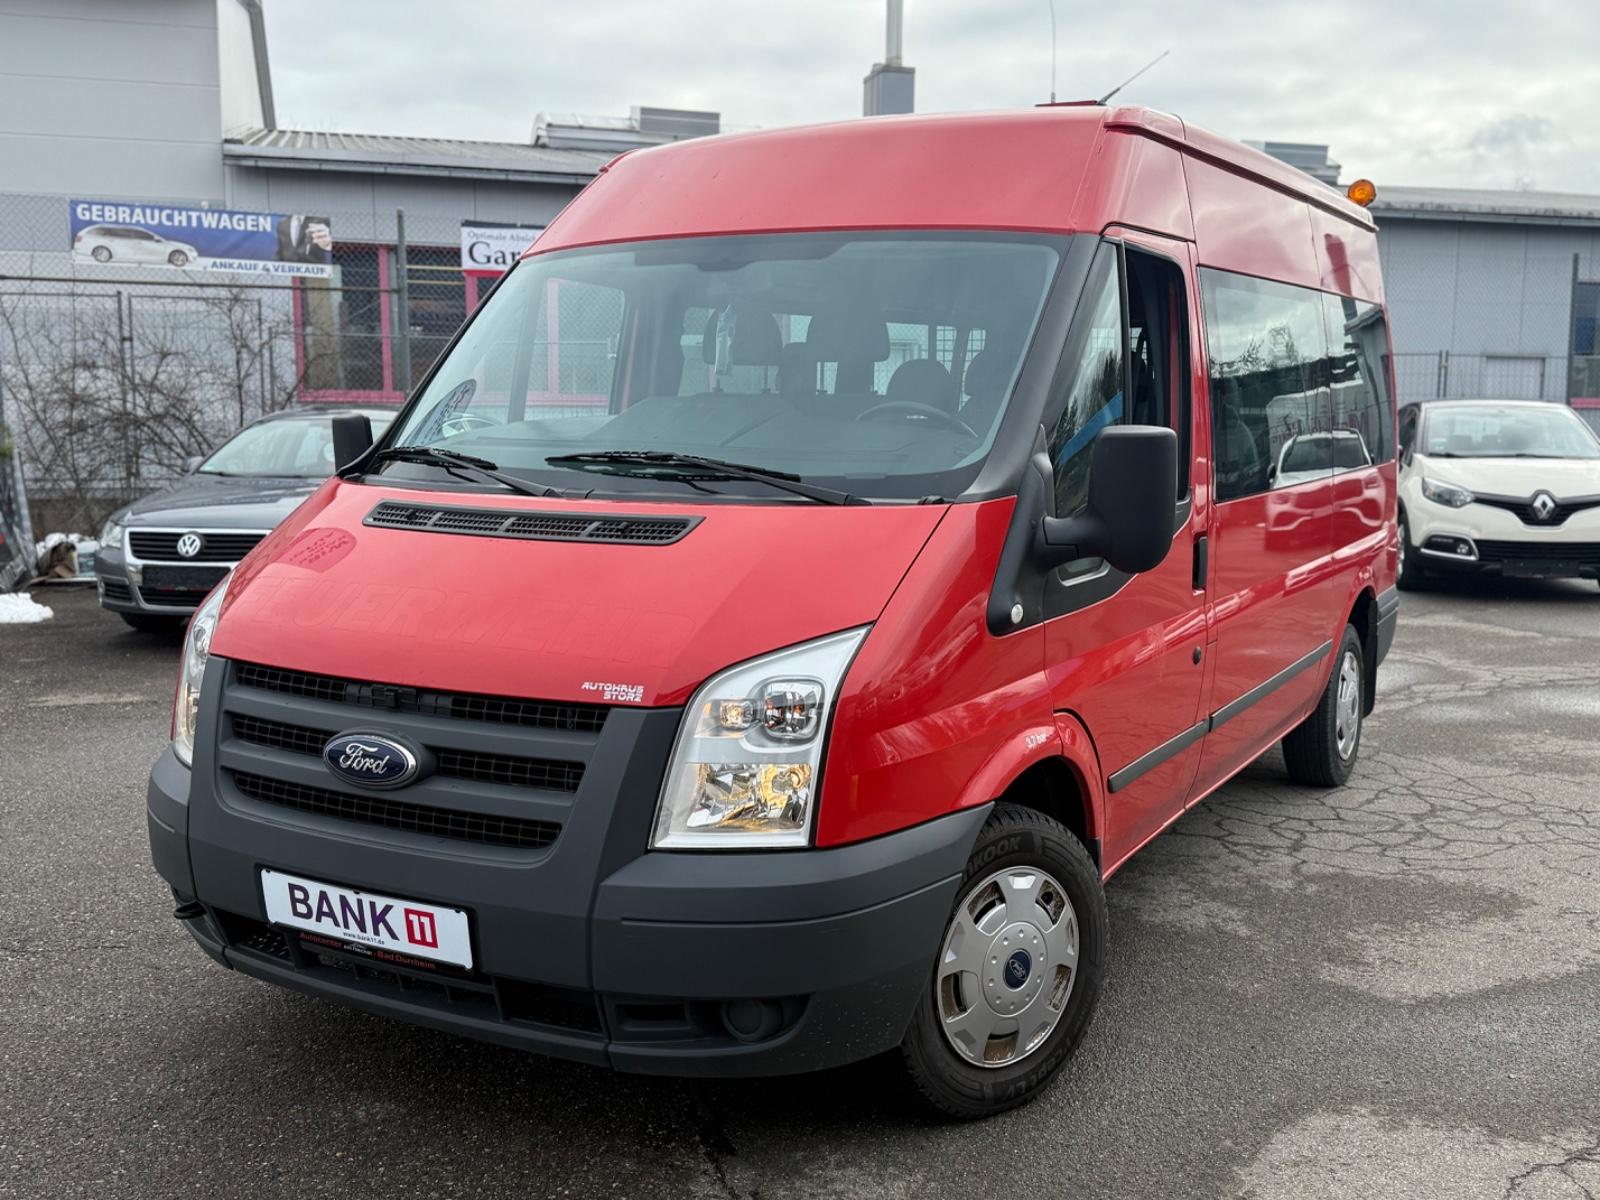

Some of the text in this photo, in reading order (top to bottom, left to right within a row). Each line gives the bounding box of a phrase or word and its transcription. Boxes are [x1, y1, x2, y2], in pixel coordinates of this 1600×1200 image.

[76, 203, 272, 232] GEBRAUCHTWAGEN
[467, 230, 507, 241] Optimale
[211, 260, 258, 272] ANKAUF
[273, 264, 327, 276] VERKAUF
[581, 682, 644, 693] AUTOHAUS
[340, 742, 390, 774] Ford
[288, 882, 433, 944] BANK 11
